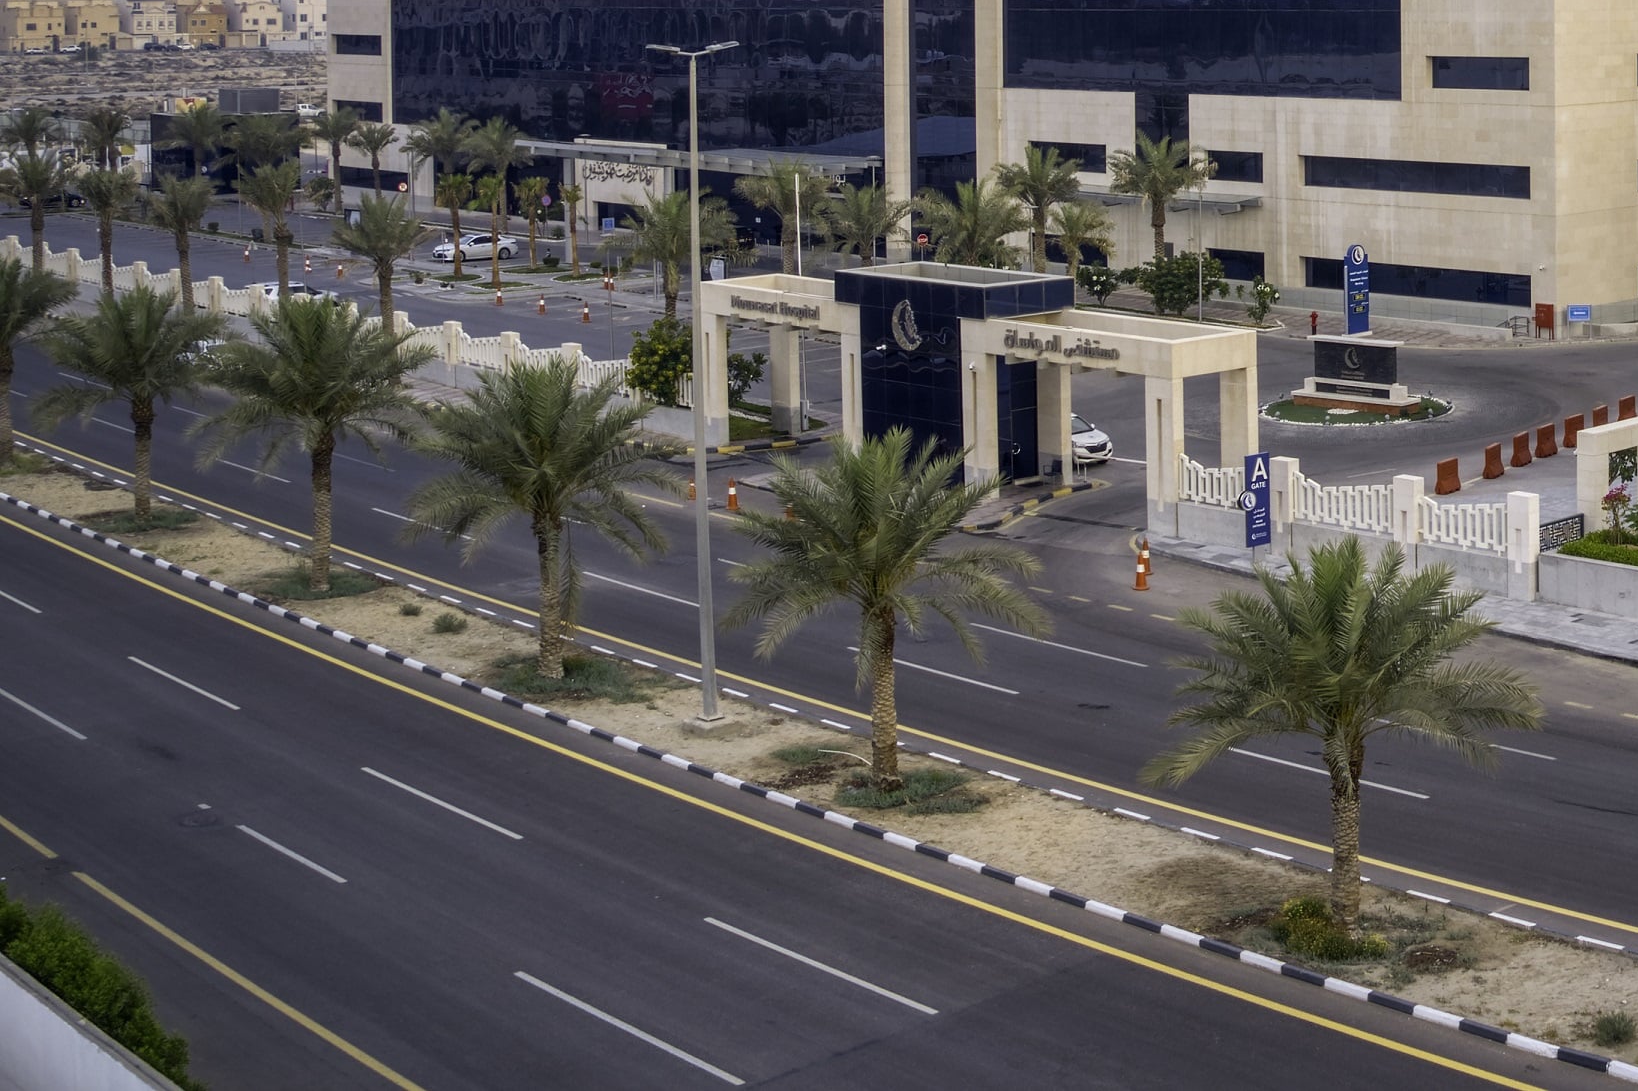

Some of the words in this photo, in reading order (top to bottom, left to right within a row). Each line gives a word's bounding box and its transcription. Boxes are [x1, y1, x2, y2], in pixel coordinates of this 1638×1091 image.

[779, 301, 820, 321] Hospital
[1004, 329, 1062, 356] المواساة
[1252, 457, 1268, 482] A
[1251, 481, 1266, 489] GATE
